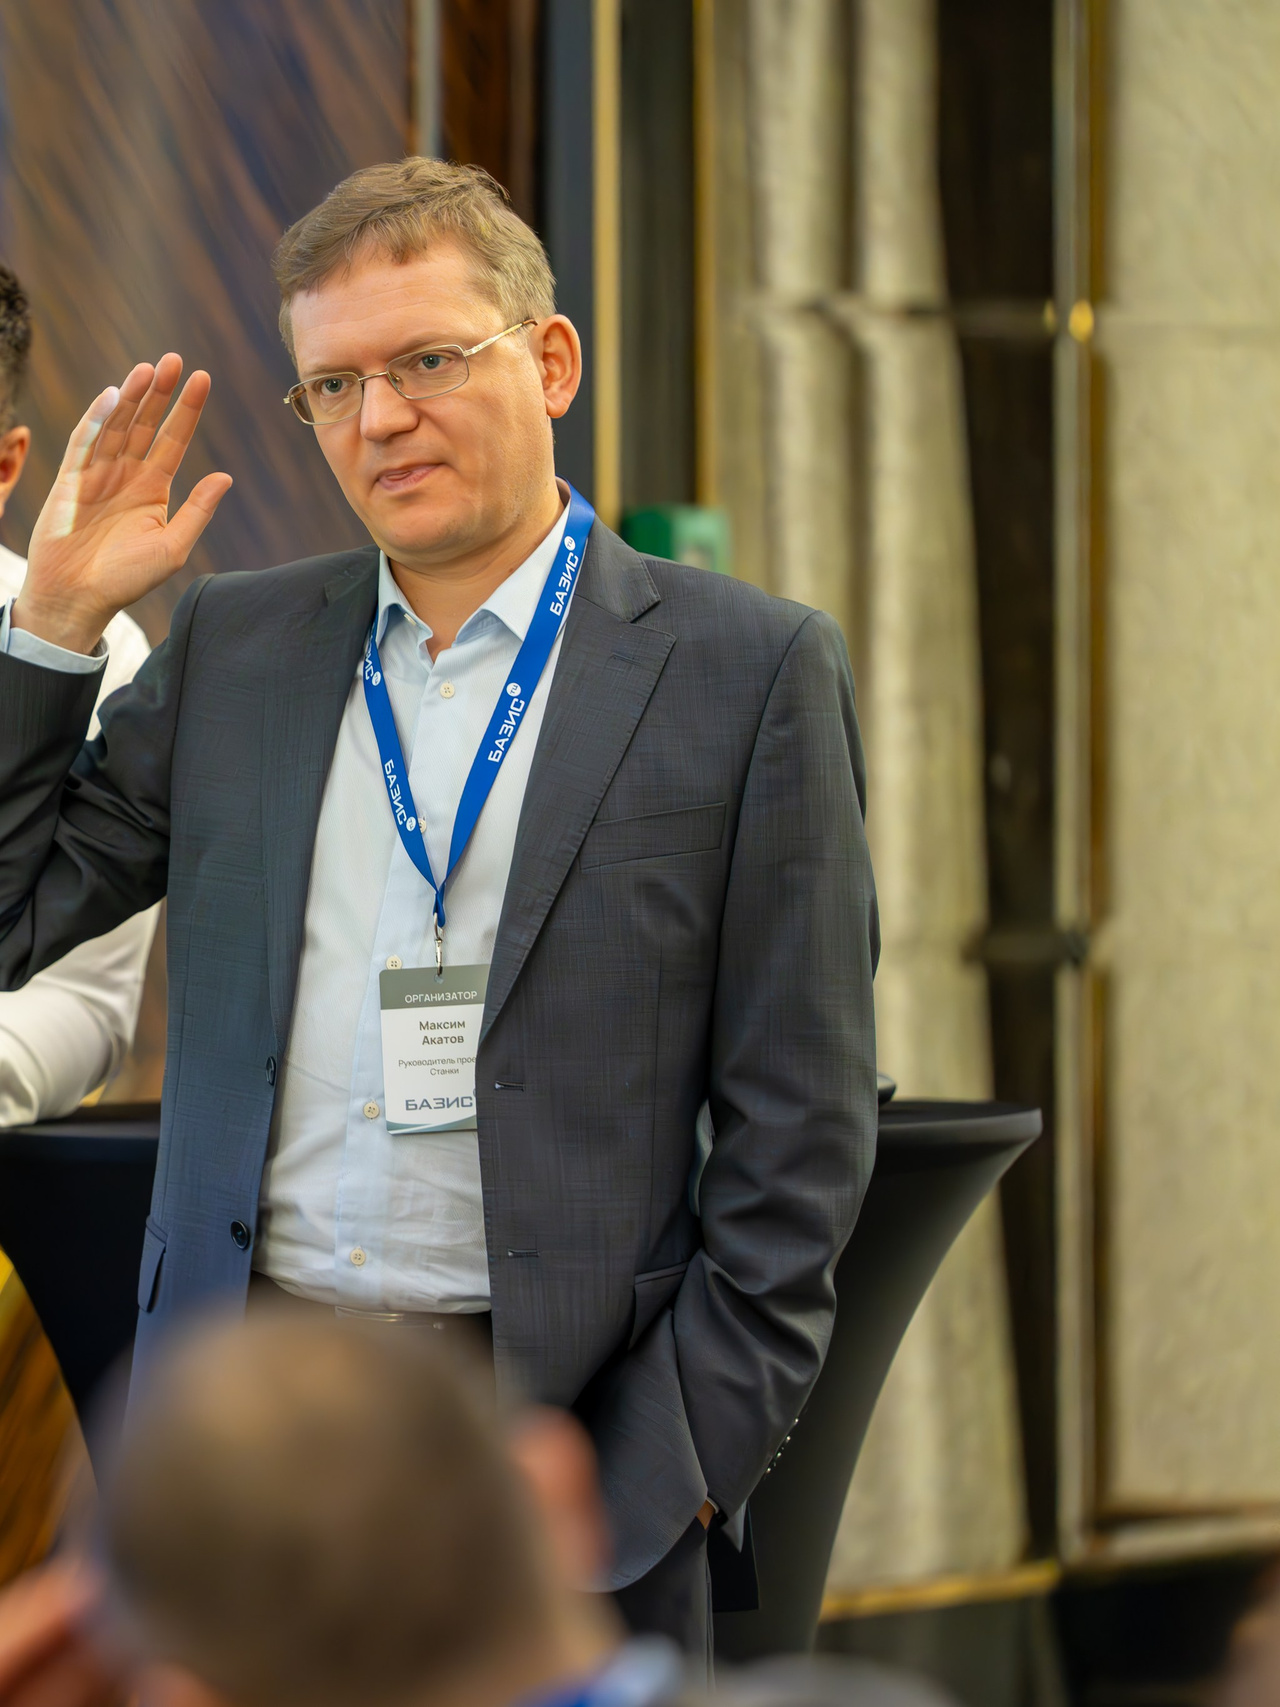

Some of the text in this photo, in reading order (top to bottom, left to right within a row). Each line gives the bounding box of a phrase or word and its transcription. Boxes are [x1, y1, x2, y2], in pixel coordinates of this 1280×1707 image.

[549, 551, 579, 617] БАЗИС
[487, 698, 526, 763] БАЗИС
[384, 758, 408, 826] БАЗИС
[404, 990, 478, 1004] ОРГАНИЗАТОР
[419, 1020, 466, 1031] Максим
[421, 1035, 465, 1046] Акатов
[398, 1057, 456, 1068] Руководитель
[429, 1067, 460, 1076] Станки
[405, 1095, 474, 1111] БАЗИС
